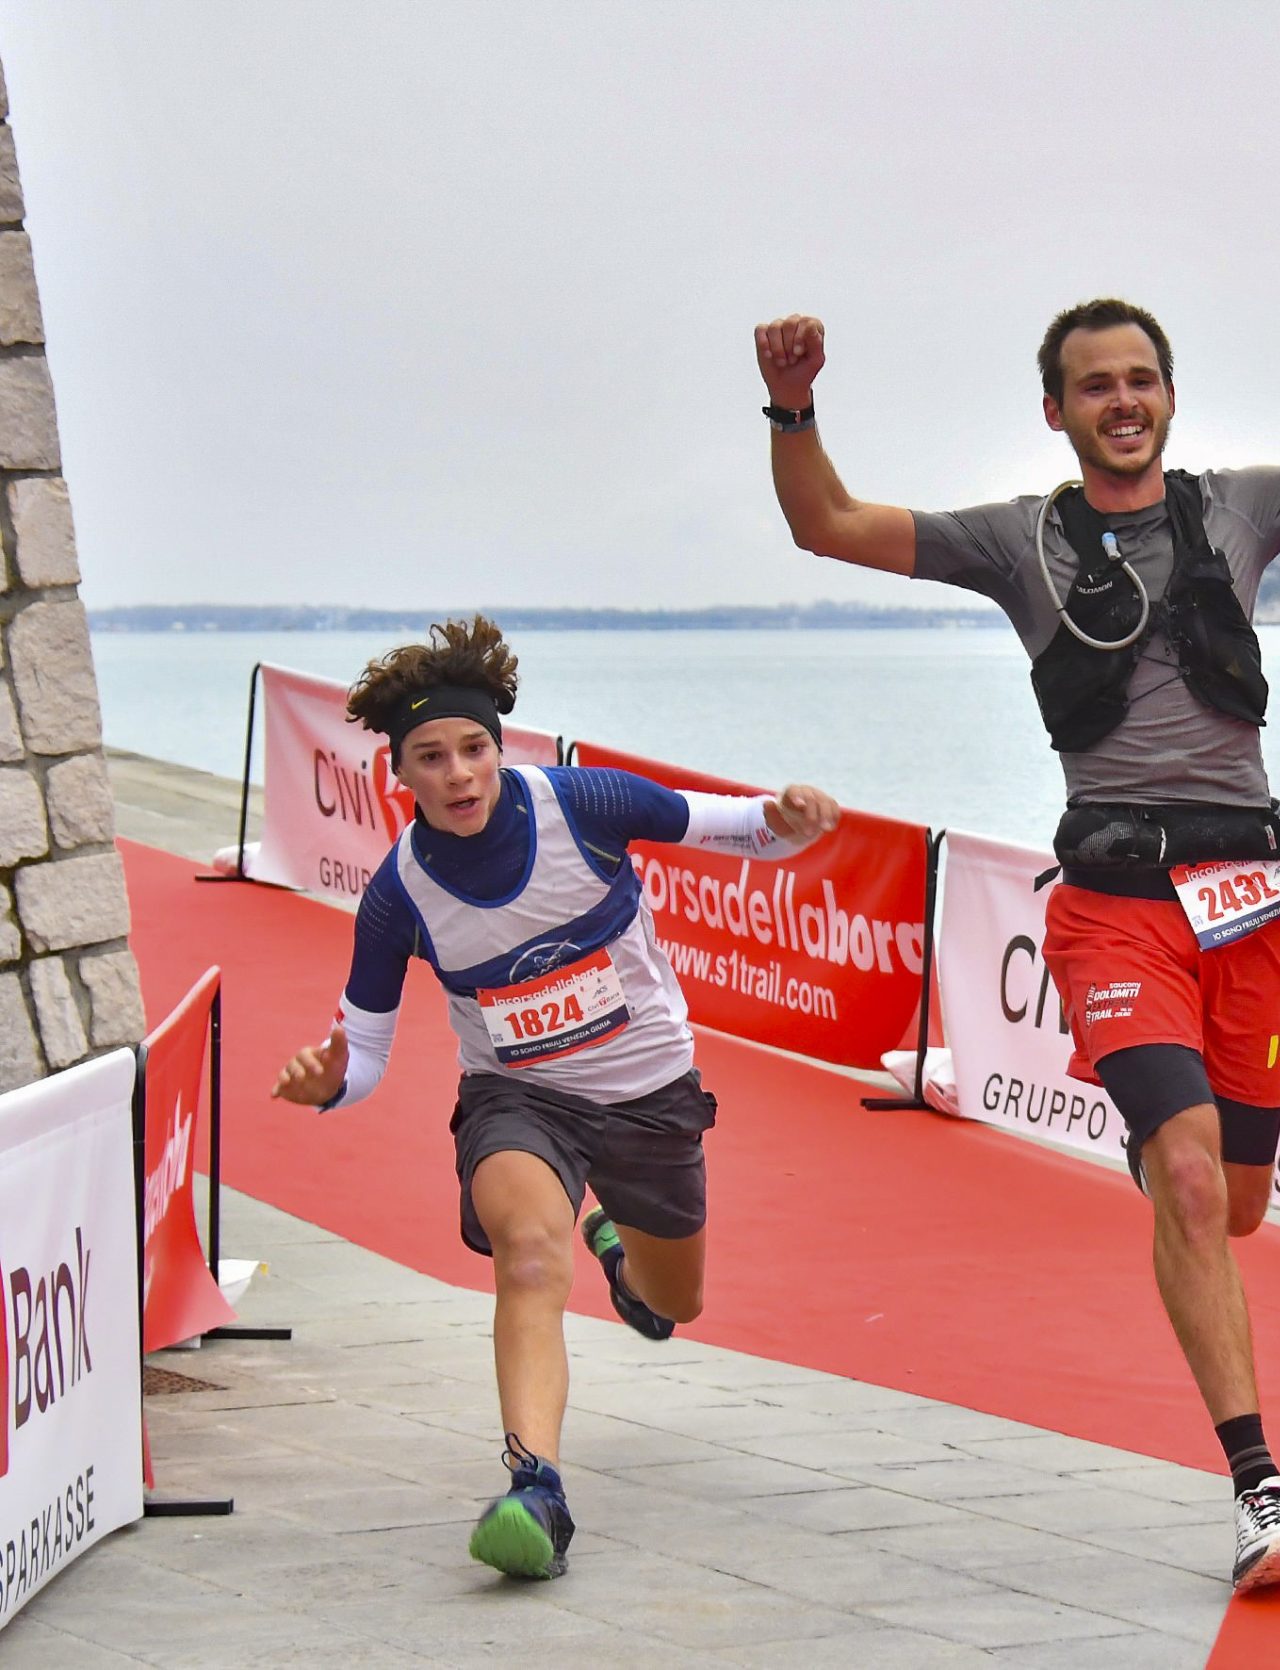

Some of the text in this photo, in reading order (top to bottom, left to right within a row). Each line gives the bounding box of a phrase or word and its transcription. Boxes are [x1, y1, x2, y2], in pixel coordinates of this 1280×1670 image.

[1197, 871, 1280, 922] 2432
[1221, 925, 1243, 938] SONO
[1091, 1009, 1113, 1023] TRAIL
[1093, 988, 1140, 1002] DOLOMITI
[504, 994, 585, 1040] 1824
[510, 1049, 520, 1057] IO
[520, 1045, 542, 1056] SONO
[562, 1030, 591, 1045] VENEZIA
[590, 1019, 612, 1034] GIULIA
[983, 1072, 1108, 1141] GRUPPO
[11, 1226, 92, 1430] Bank
